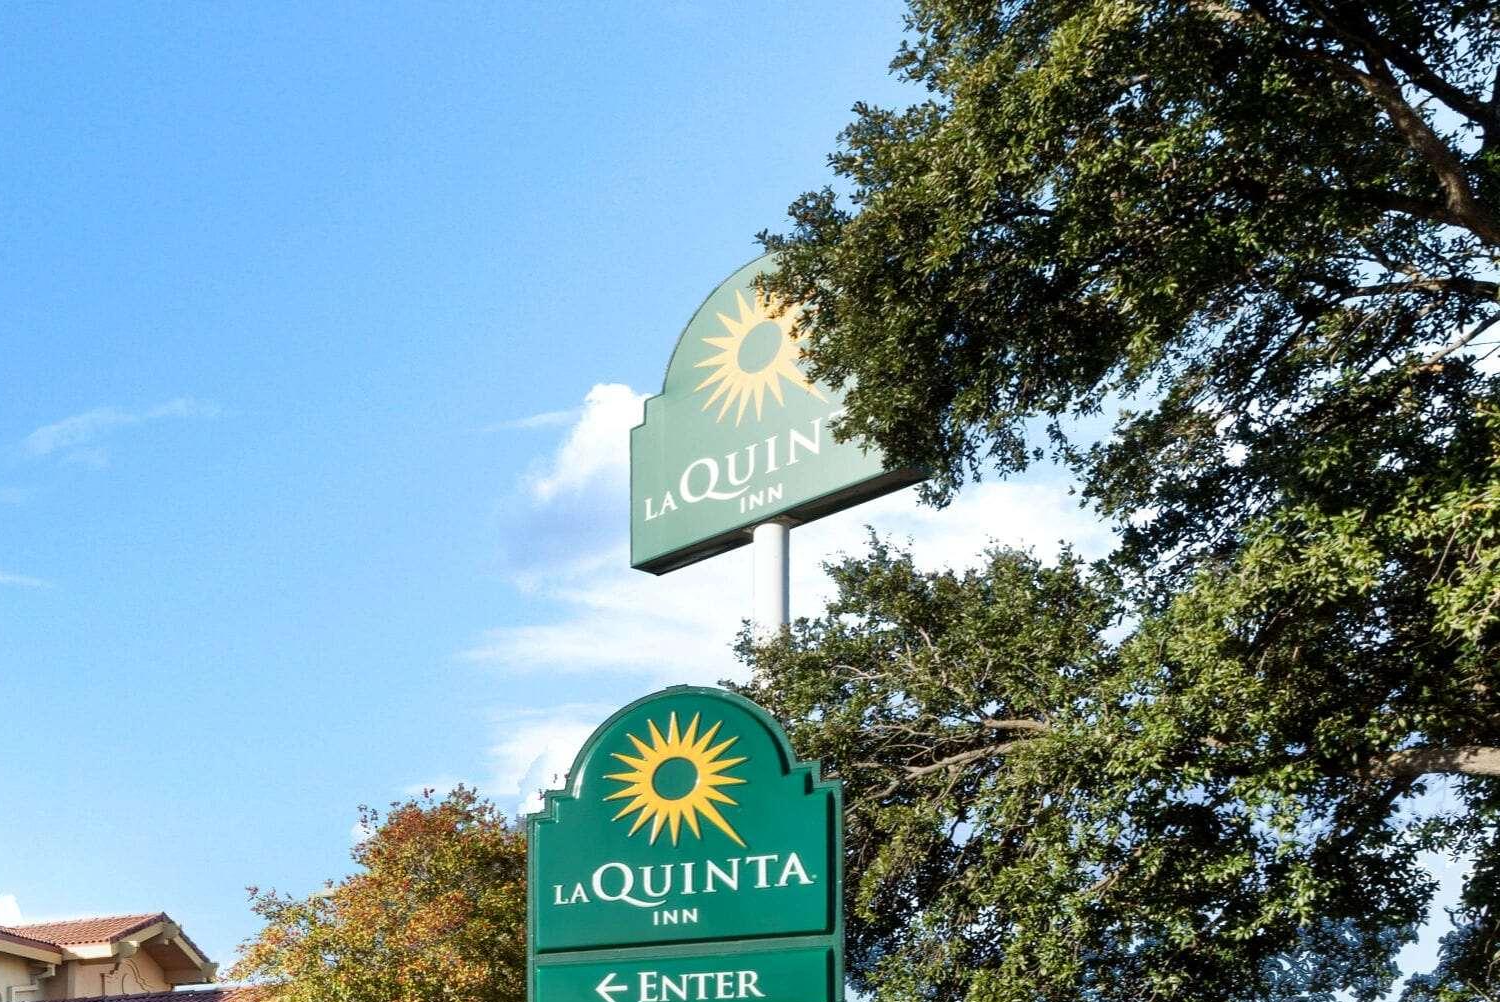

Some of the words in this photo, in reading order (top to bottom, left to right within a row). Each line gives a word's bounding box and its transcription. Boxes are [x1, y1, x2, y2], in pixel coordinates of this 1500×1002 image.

[643, 490, 678, 521] LA
[680, 406, 849, 503] QUIN
[740, 483, 783, 514] INN
[553, 883, 589, 905] LA
[592, 852, 814, 907] QUINTA
[653, 908, 698, 926] INN
[638, 970, 765, 1002] ENTER
